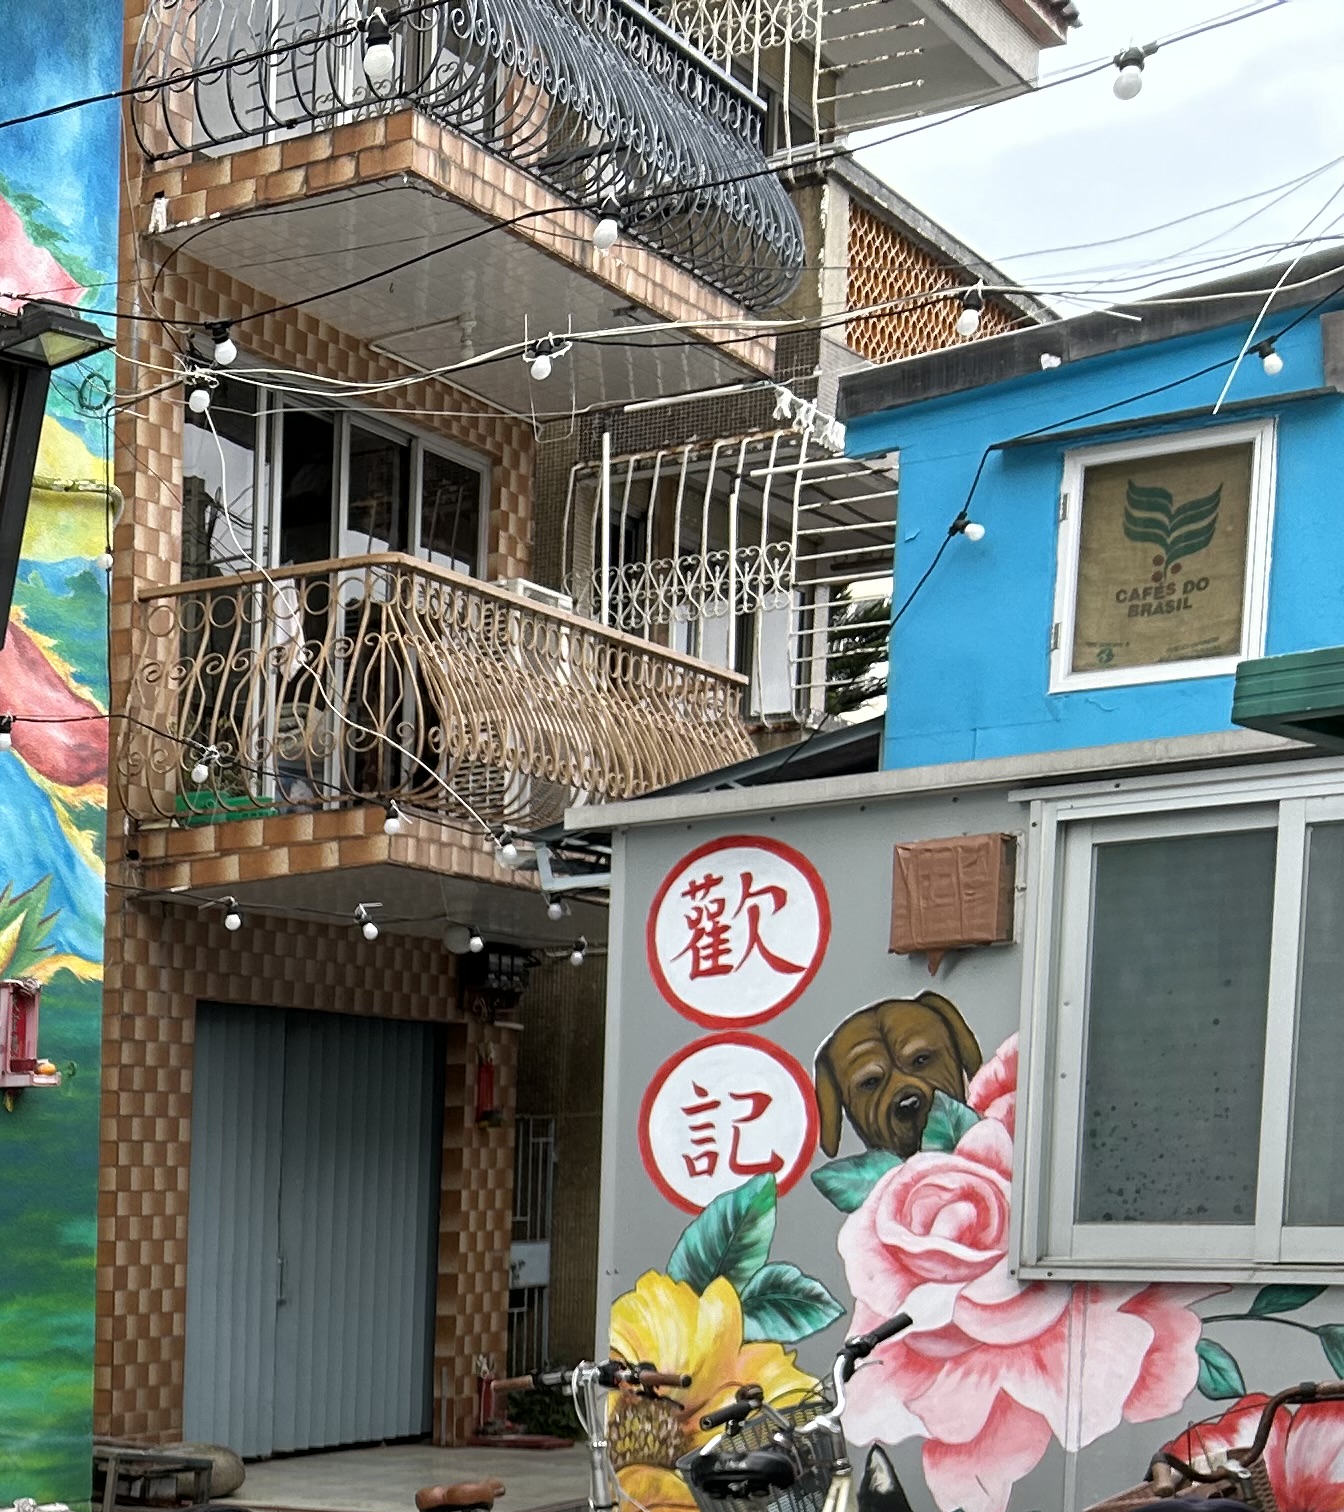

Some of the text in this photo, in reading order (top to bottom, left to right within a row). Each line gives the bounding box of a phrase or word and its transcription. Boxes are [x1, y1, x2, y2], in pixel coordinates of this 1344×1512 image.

[1115, 577, 1210, 604] CAFÉS DO
[1127, 597, 1193, 618] BRASIL
